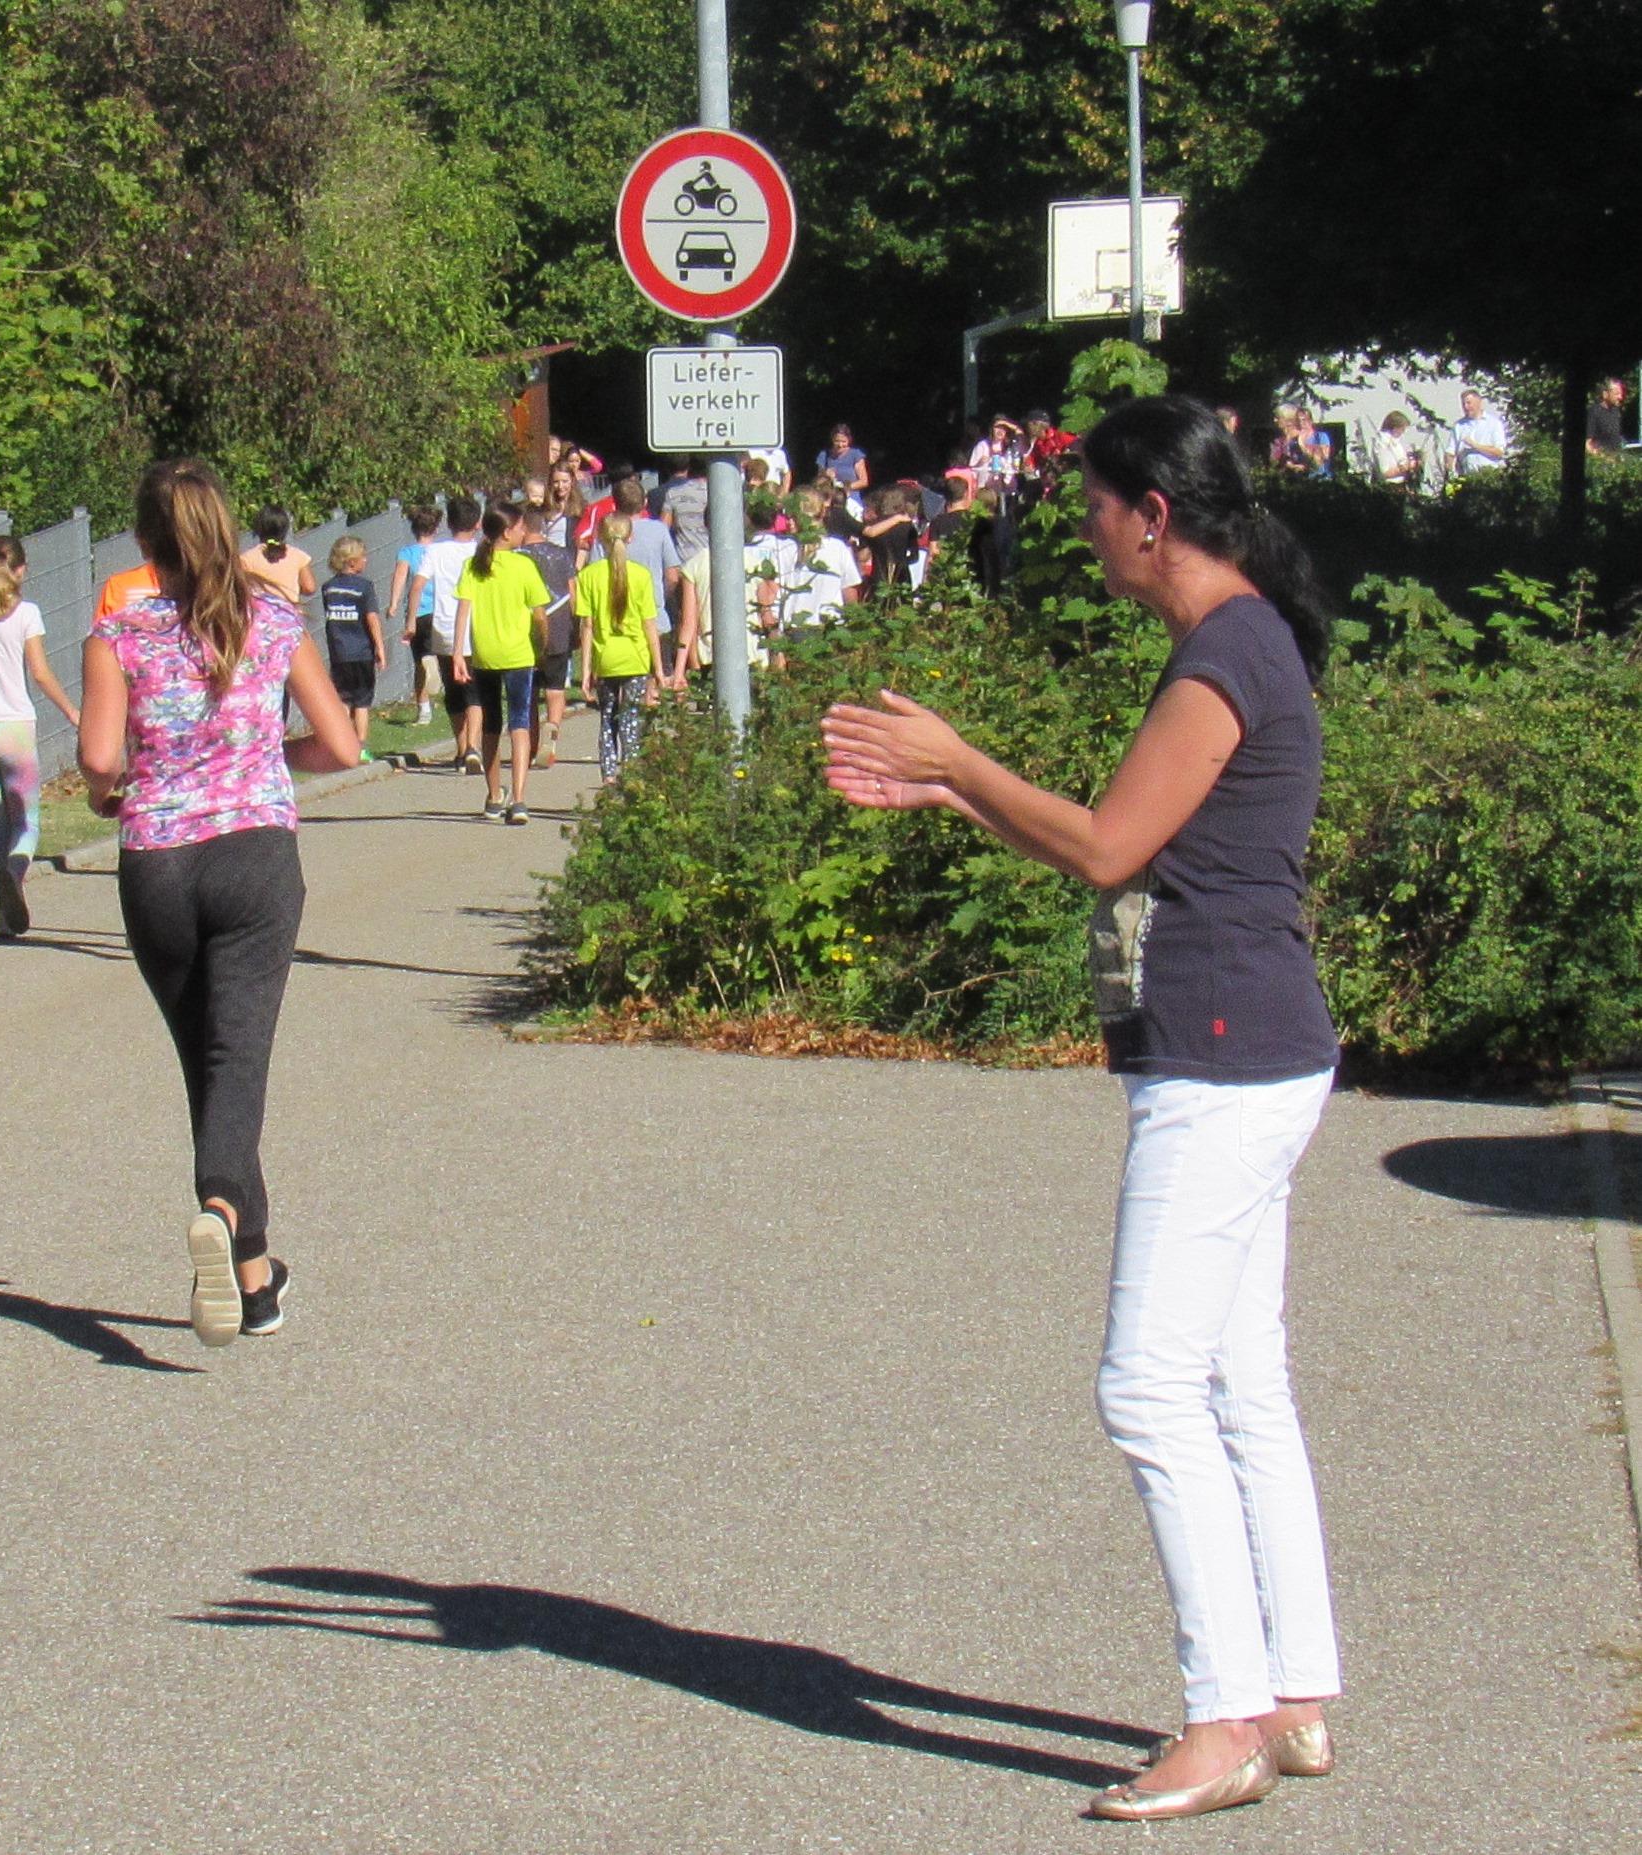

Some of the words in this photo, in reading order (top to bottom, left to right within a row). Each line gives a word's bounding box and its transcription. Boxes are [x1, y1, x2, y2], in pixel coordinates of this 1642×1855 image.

[673, 362, 754, 383] Liefer-
[668, 389, 760, 410] verkehr
[696, 416, 736, 437] frei
